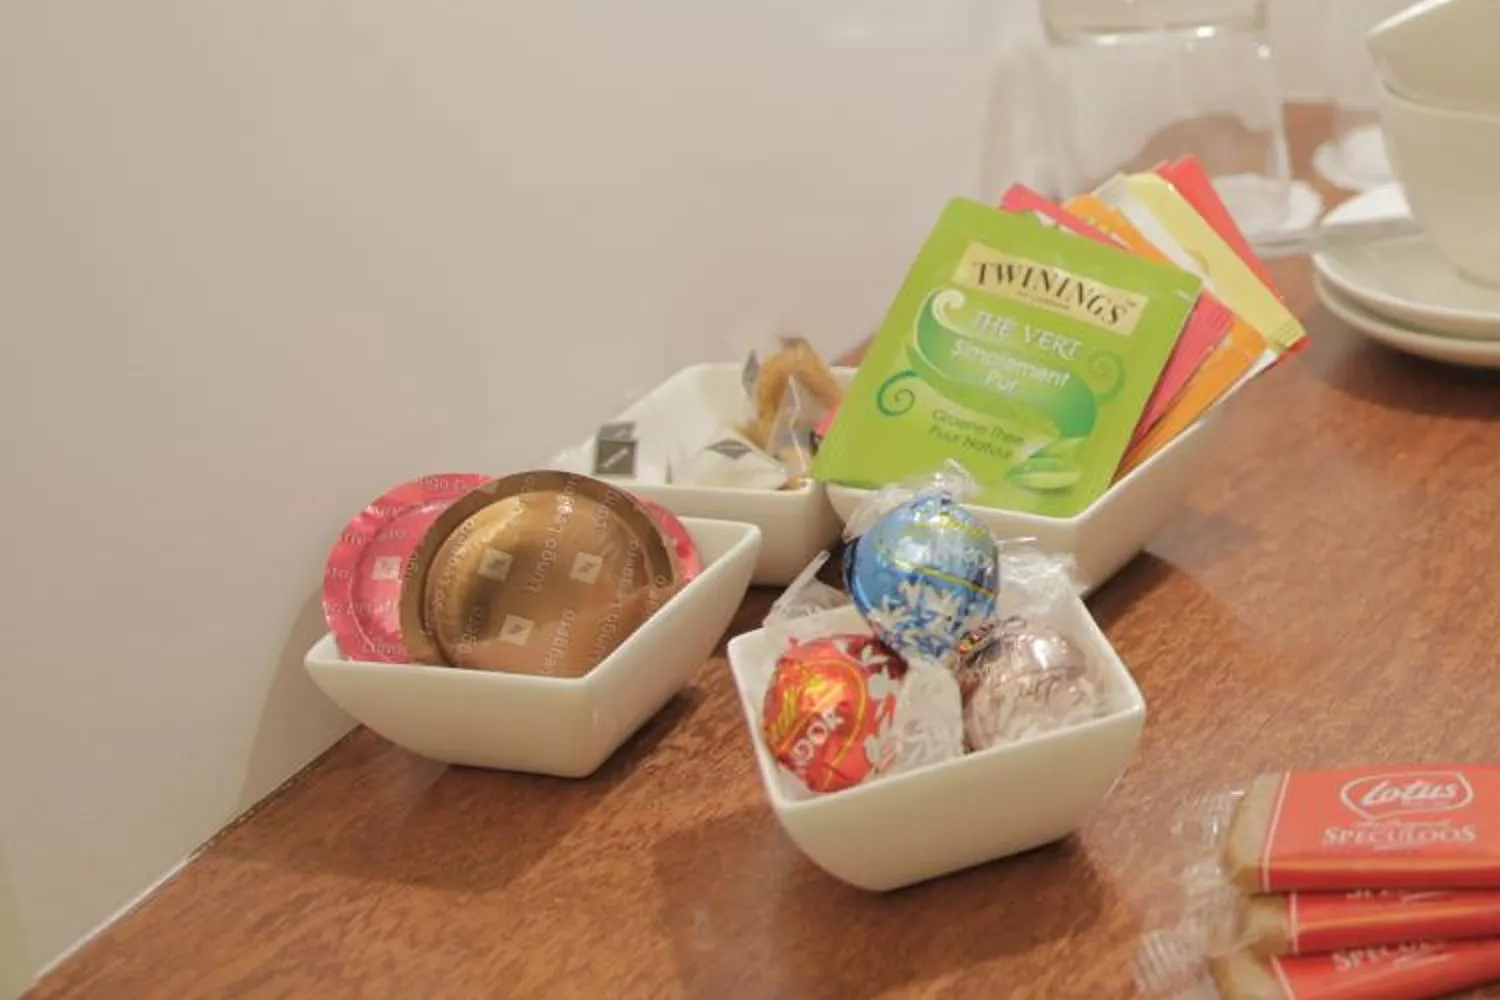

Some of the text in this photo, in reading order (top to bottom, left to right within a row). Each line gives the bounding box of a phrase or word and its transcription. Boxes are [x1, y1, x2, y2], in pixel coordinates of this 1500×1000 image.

[974, 261, 1128, 326] TWININGS
[951, 338, 1071, 389] Simplement
[1023, 322, 1084, 361] VERT
[527, 538, 557, 592] Lungo
[1361, 779, 1458, 806] Lotus
[1323, 824, 1477, 846] SPECULOOS
